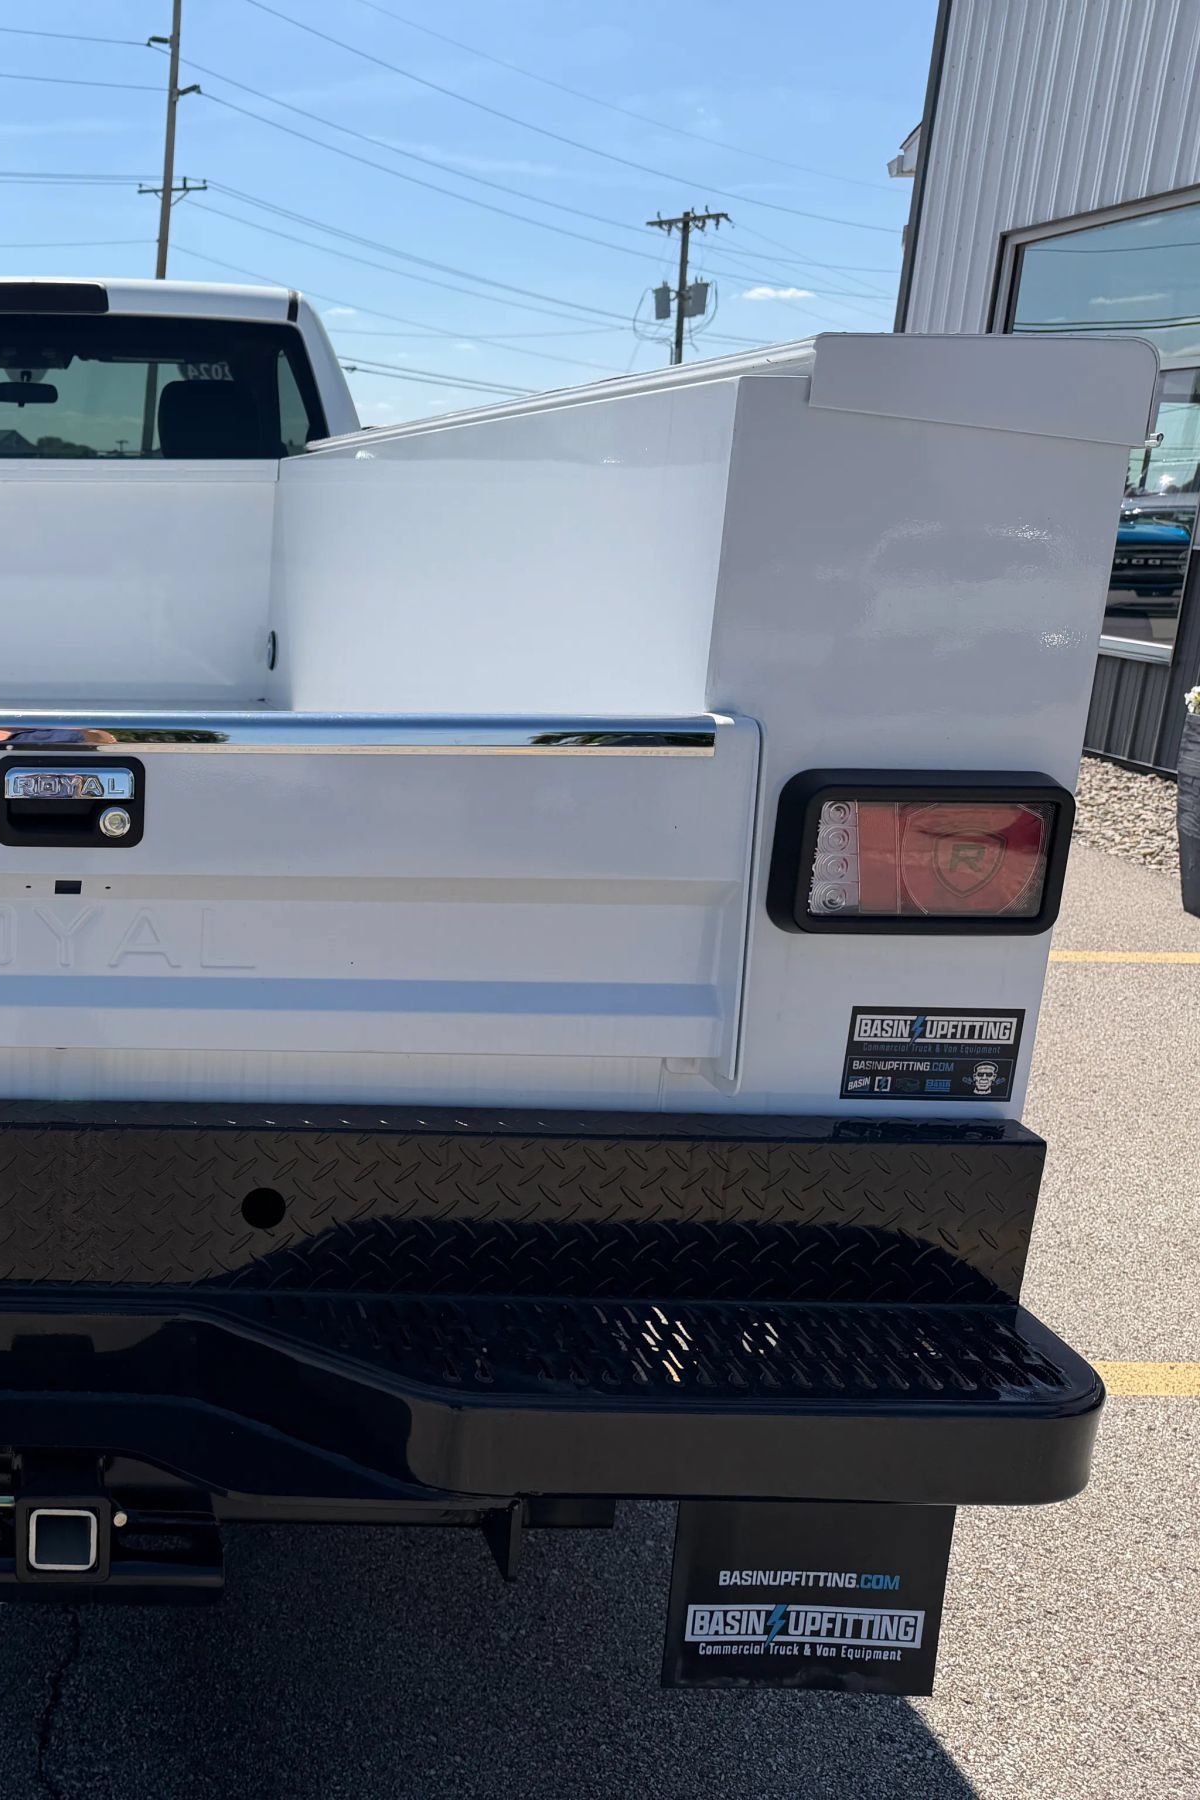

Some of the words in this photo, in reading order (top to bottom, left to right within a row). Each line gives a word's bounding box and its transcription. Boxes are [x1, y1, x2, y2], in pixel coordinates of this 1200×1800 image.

[13, 775, 125, 797] ROYAL
[859, 1019, 911, 1038] BASIN
[925, 1021, 1012, 1040] UPFITTING
[852, 1060, 955, 1072] BASINUPFITTING.COM
[847, 1076, 871, 1091] BASIN
[718, 1570, 900, 1591] BASINUPFITTING.COM
[693, 1610, 767, 1636] BASIN
[787, 1611, 915, 1642] UPFITTING
[698, 1643, 765, 1656] Commercial
[768, 1643, 799, 1656] Truck
[803, 1645, 811, 1657] &
[815, 1645, 836, 1658] Van
[840, 1646, 902, 1662] Equipment
